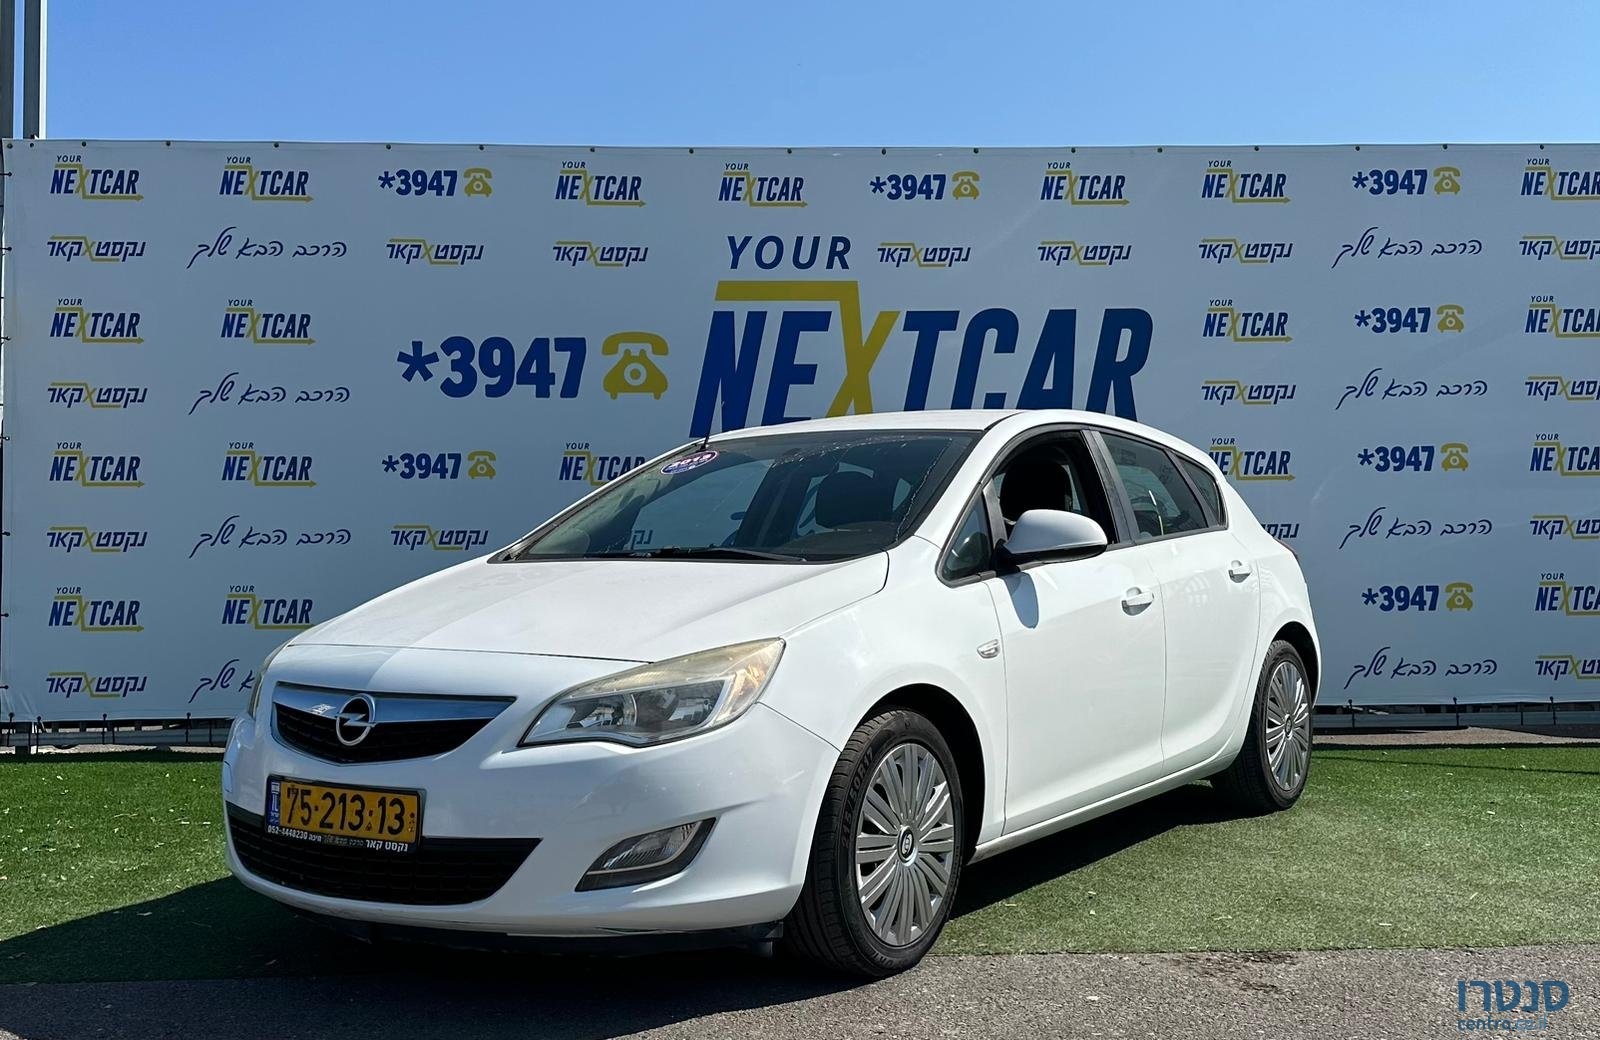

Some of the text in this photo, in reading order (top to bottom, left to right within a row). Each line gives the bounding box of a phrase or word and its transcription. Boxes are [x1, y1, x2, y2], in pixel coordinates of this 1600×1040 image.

[56, 154, 82, 163] YOUR
[226, 155, 252, 164] YOUR
[561, 160, 586, 169] YOUR
[725, 162, 749, 171] YOUR
[1047, 161, 1071, 170] YOUR
[1208, 159, 1232, 168] YOUR
[1526, 158, 1550, 166] YOUR
[50, 170, 139, 194] NEXTCAR
[220, 170, 309, 195] NEXTCAR
[555, 176, 641, 200] NEXTCAR
[719, 177, 804, 201] NEXTCAR
[1041, 175, 1125, 200] NEXTCAR
[1202, 173, 1286, 198] NEXTCAR
[187, 227, 347, 269] הרכב הבא שלך
[727, 235, 852, 271] YOUR
[1331, 227, 1482, 268] הרכב הבא שלך
[57, 298, 83, 306] YOUR
[227, 298, 253, 307] YOUR
[1209, 298, 1233, 307] YOUR
[1530, 295, 1554, 303] YOUR
[50, 313, 140, 337] NEXTCAR
[221, 314, 310, 338] NEXTCAR
[1203, 312, 1288, 337] NEXTCAR
[1525, 309, 1600, 333] NEXTCA
[689, 308, 1153, 438] NEXTCAR
[188, 372, 350, 415] הרכב הבא שלך
[1335, 368, 1487, 410] הרכב הבא שלך
[56, 441, 82, 450] YOUR
[228, 441, 255, 450] YOUR
[565, 442, 590, 450] YOUR
[1211, 437, 1236, 446] YOUR
[1535, 433, 1560, 441] YOUR
[50, 456, 140, 481] NEXTCAR
[222, 456, 312, 481] NEXTCAR
[189, 515, 351, 558] הרכב הבא שלך
[1339, 507, 1492, 549] הרכב הבא שלך
[229, 584, 255, 593] YOUR
[1540, 572, 1565, 581] YOUR
[56, 586, 82, 595] YOUR
[49, 601, 140, 626] NEXTCAR
[222, 599, 312, 624] NEXTCAR
[1344, 647, 1497, 689] הרכב הבא שלך
[188, 659, 239, 703] שלך
